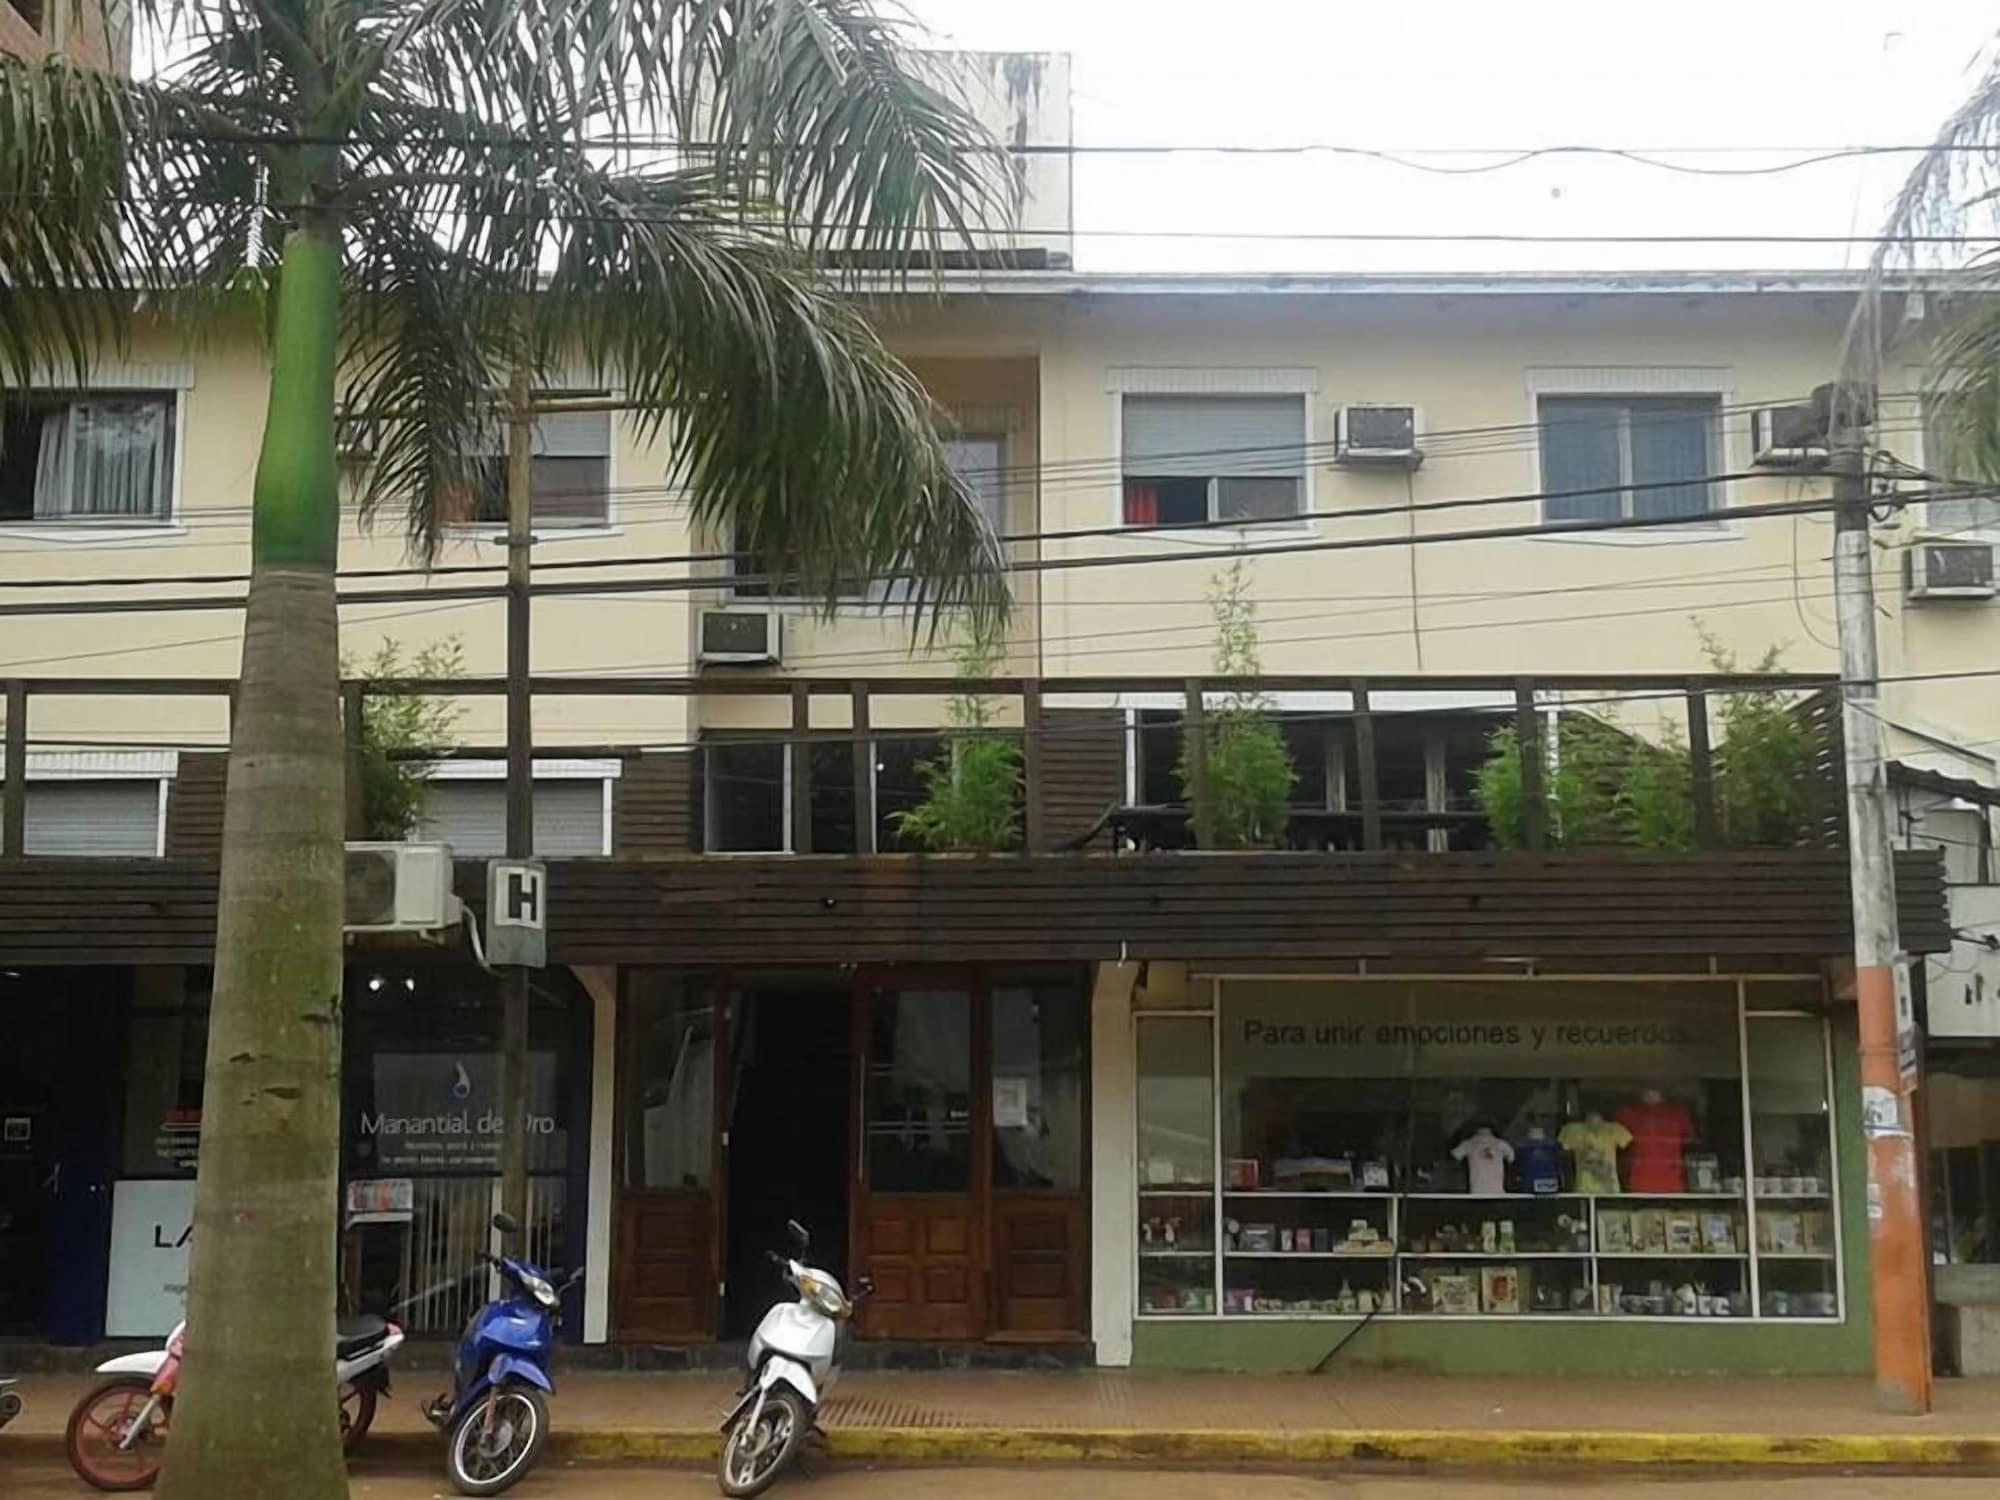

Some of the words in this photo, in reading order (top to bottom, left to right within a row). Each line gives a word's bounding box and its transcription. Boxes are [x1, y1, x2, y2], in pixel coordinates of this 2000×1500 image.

[508, 873, 538, 922] H
[1243, 1018, 1306, 1045] Para
[1315, 1019, 1364, 1046] unir
[1376, 1020, 1520, 1046] emociones
[1531, 1023, 1547, 1051] y
[360, 1110, 473, 1136] Manantial
